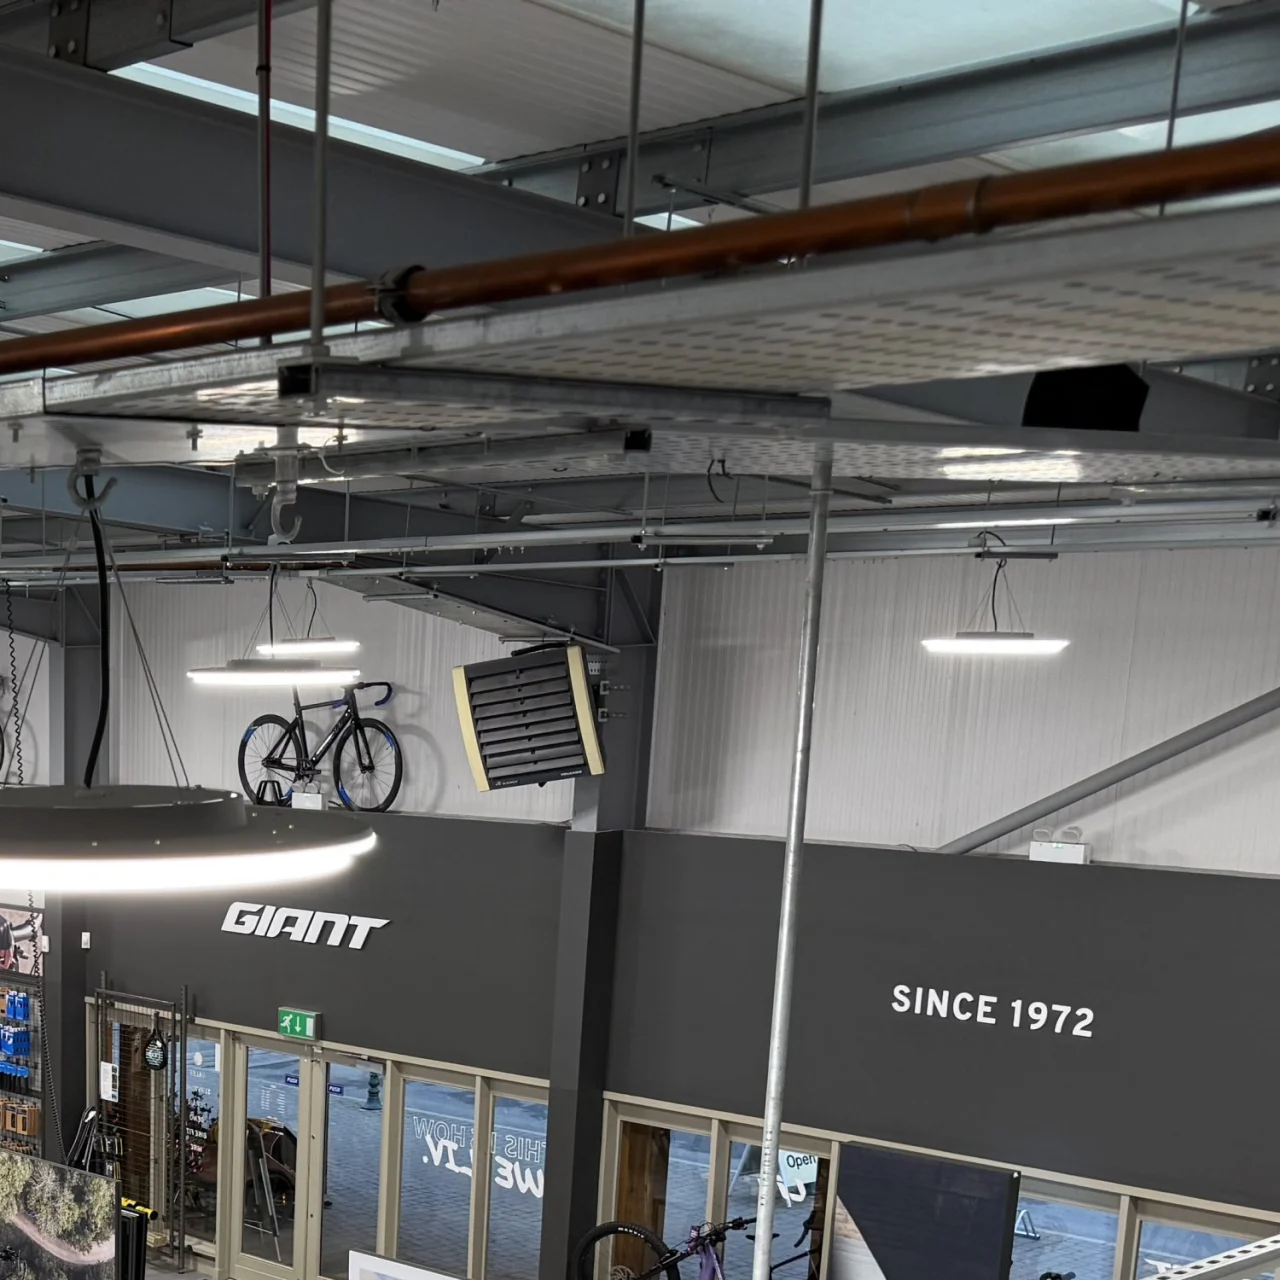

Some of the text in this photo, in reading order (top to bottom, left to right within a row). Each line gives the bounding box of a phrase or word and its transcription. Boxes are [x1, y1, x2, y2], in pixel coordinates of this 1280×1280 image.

[221, 901, 391, 950] GIANT
[891, 984, 1094, 1038] SINCE 1972
[786, 1154, 816, 1170] Open
